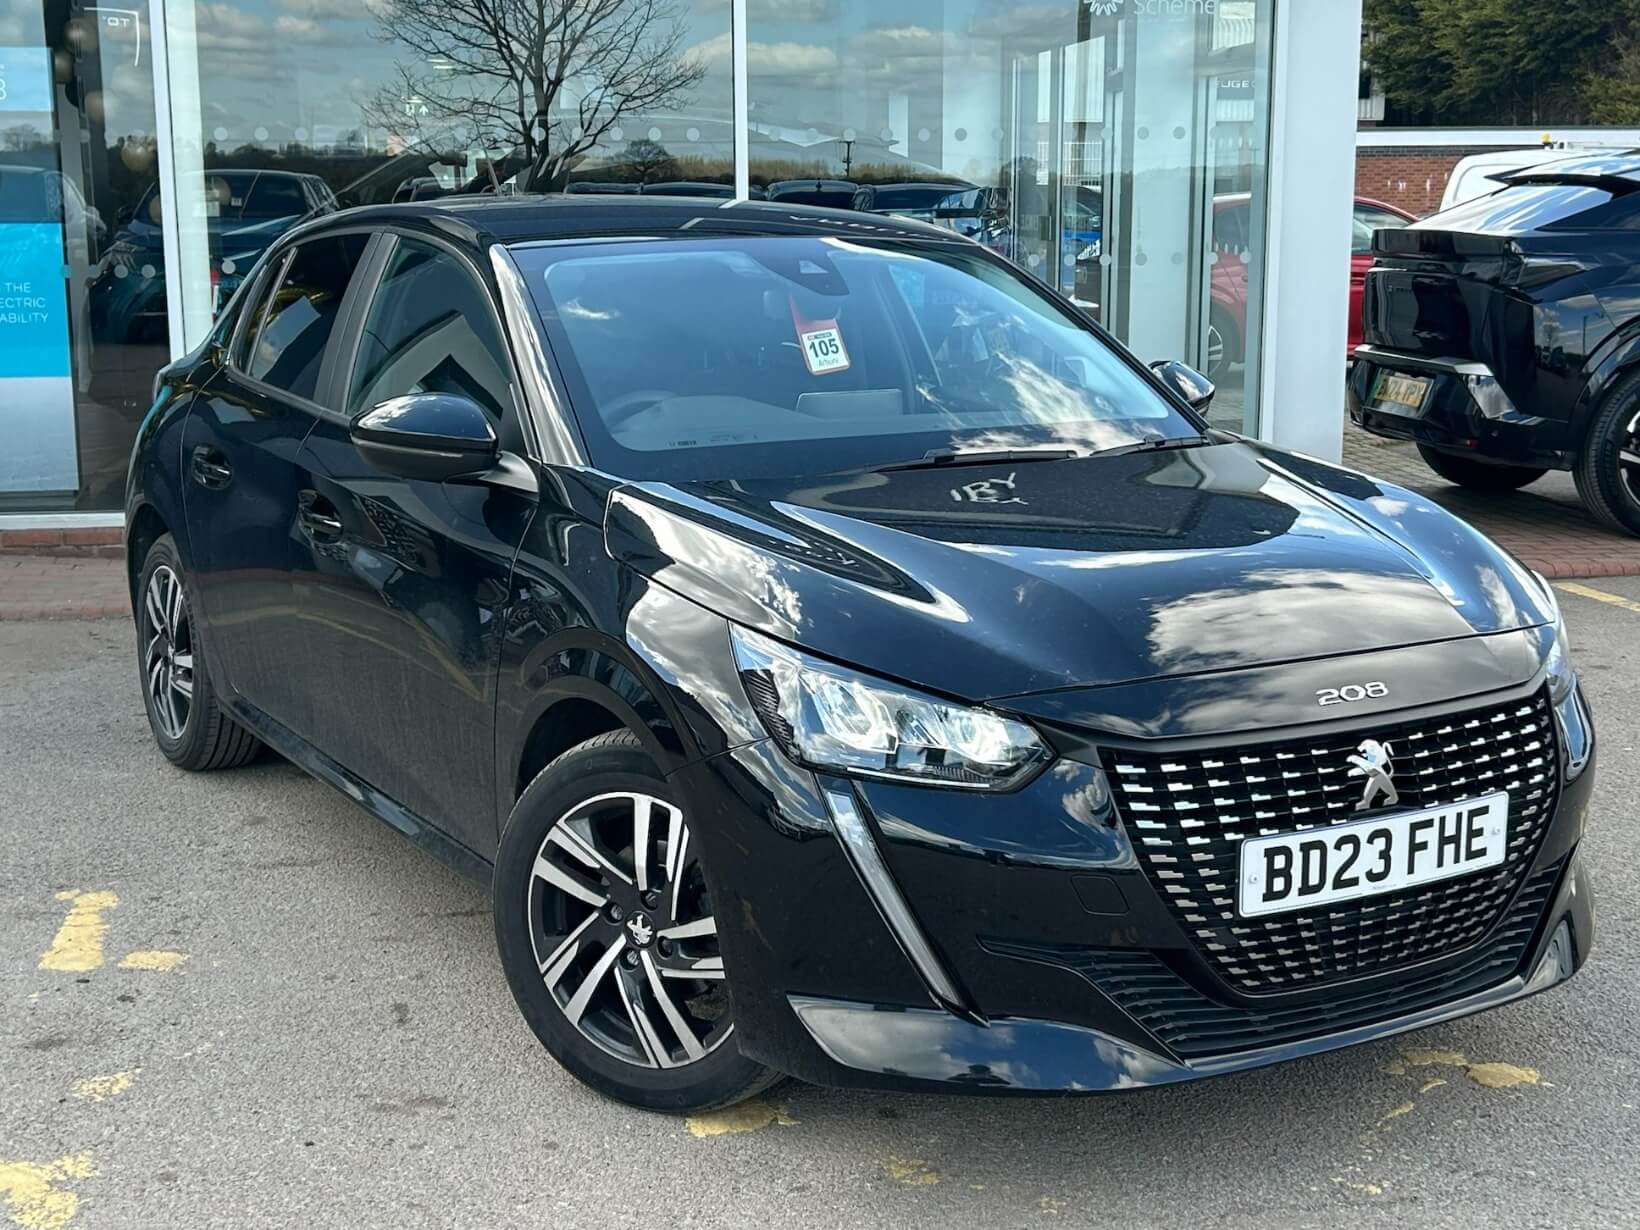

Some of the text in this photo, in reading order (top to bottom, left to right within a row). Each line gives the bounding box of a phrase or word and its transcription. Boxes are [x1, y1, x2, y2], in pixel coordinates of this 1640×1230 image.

[1133, 0, 1215, 15] Scheme
[4, 281, 32, 293] THE
[0, 312, 49, 324] ABILITY
[809, 338, 840, 358] 105
[1315, 681, 1389, 706] 208
[1262, 804, 1490, 903] BD23 FHE
